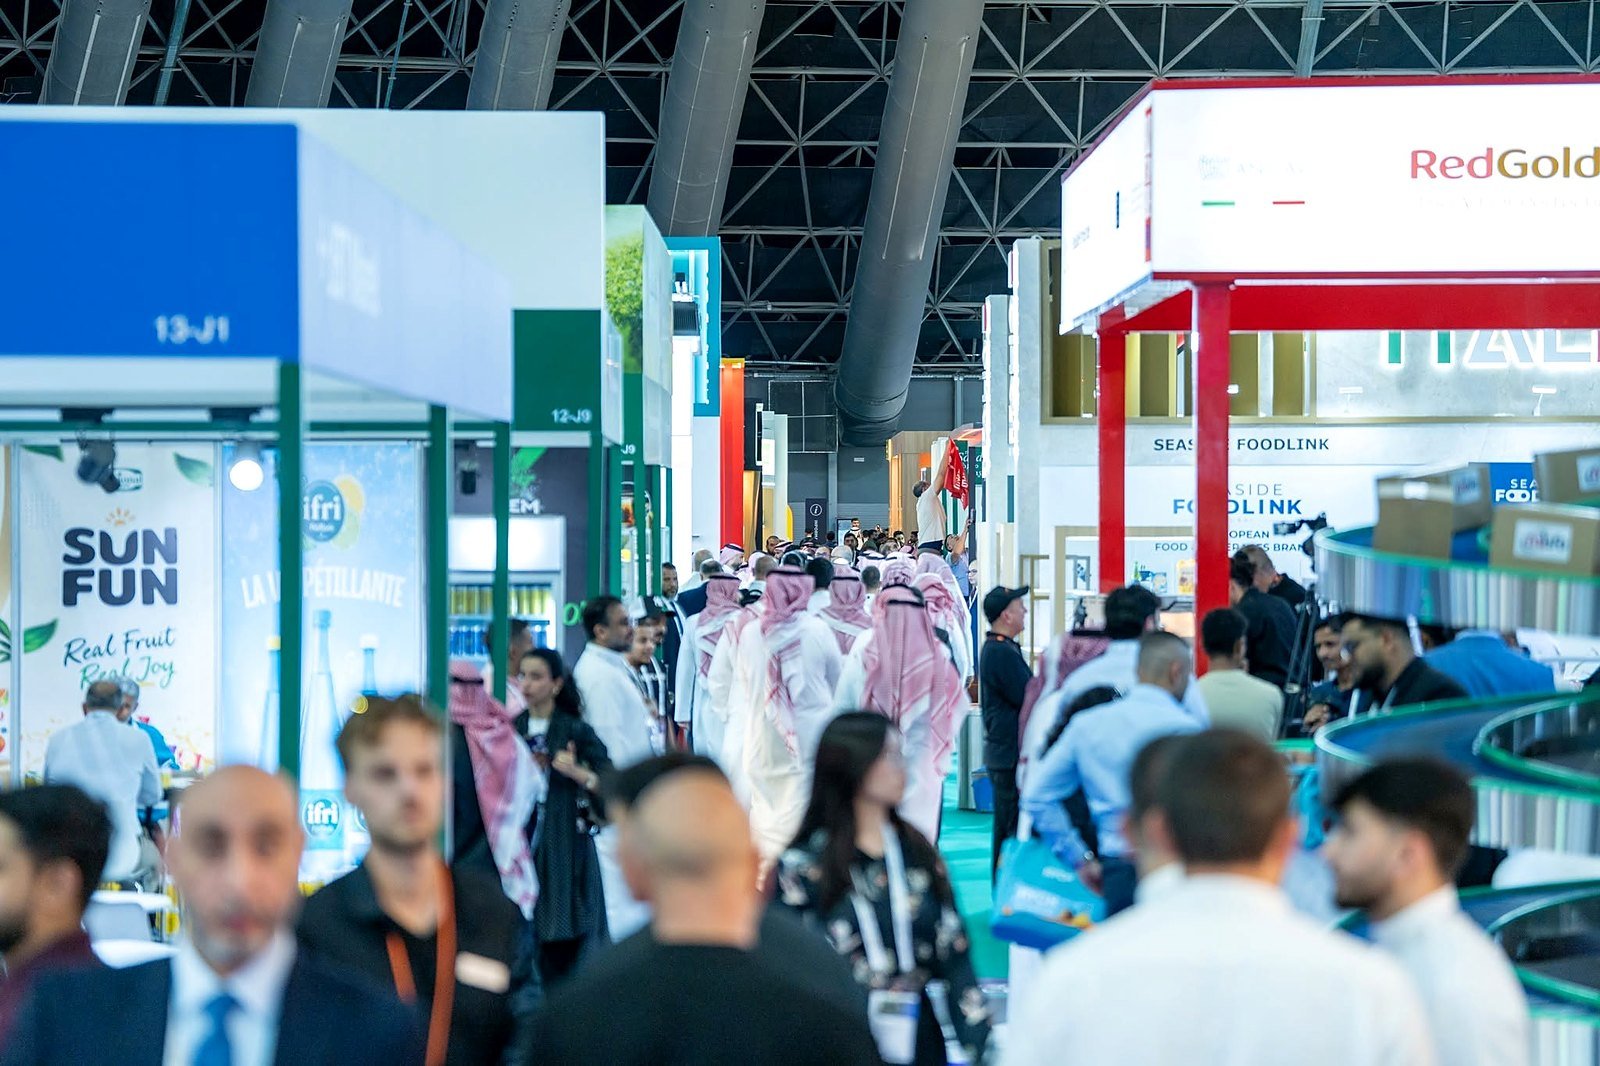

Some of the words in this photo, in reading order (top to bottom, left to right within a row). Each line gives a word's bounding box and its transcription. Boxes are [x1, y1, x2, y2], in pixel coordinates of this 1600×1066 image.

[155, 314, 229, 345] 13-J1
[552, 409, 592, 423] 12-J9
[1238, 438, 1329, 450] FOODLINK
[1228, 484, 1283, 496] SIDE
[1510, 479, 1539, 488] SEA
[303, 494, 342, 521] ifri
[509, 499, 540, 514] EM
[1229, 531, 1269, 539] OPEAN
[63, 527, 178, 565] SUN
[1155, 543, 1188, 551] FOOD
[62, 568, 178, 607] FUN
[63, 634, 116, 667] Real
[123, 627, 175, 655] Fruit
[136, 656, 175, 689] Joy
